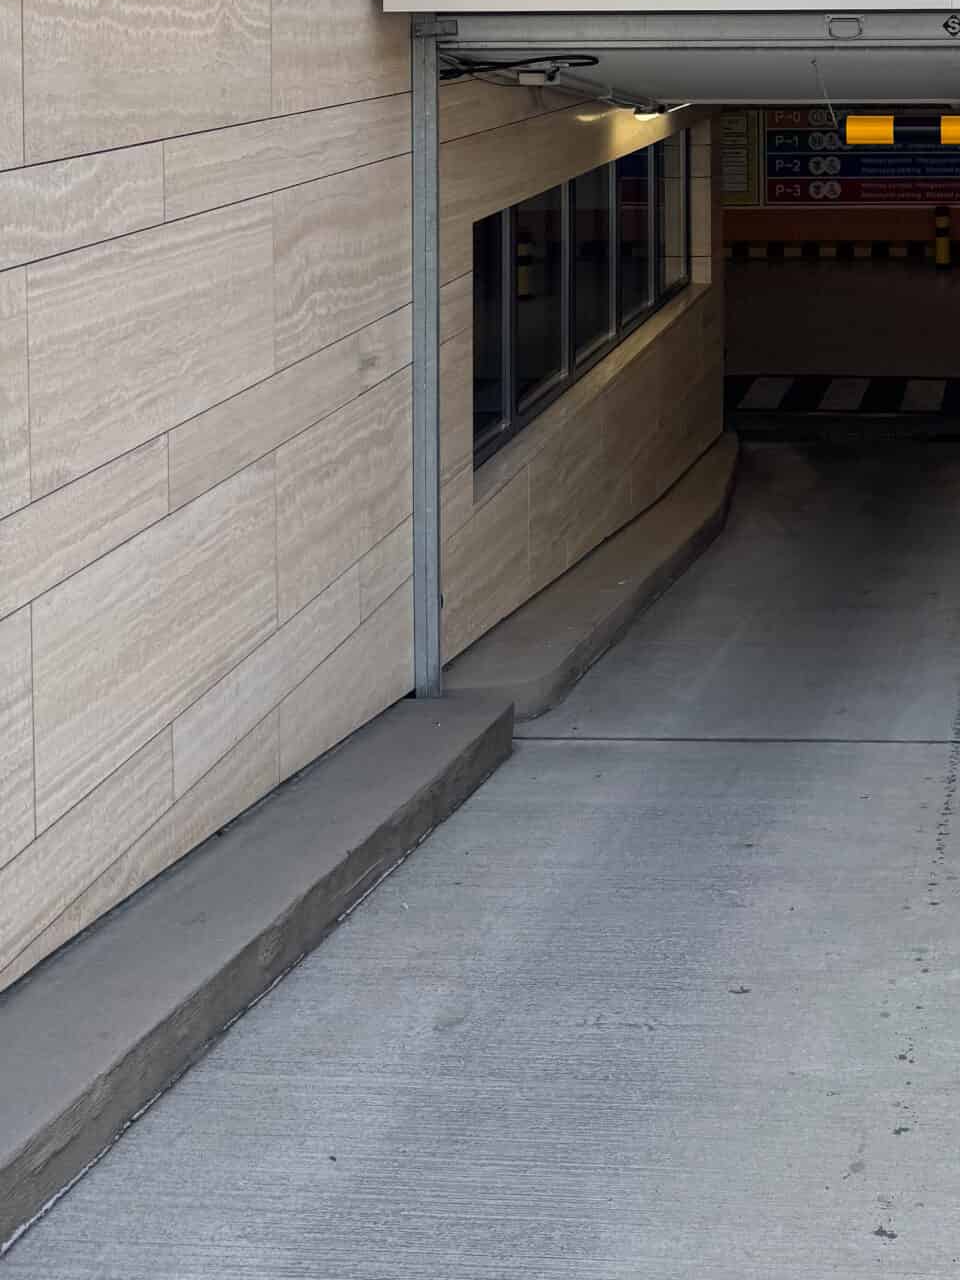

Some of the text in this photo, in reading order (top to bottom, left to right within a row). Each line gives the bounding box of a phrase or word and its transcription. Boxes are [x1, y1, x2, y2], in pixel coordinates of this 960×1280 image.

[775, 135, 799, 148] P-1
[775, 159, 801, 173] P-2
[775, 183, 801, 197] P-3
